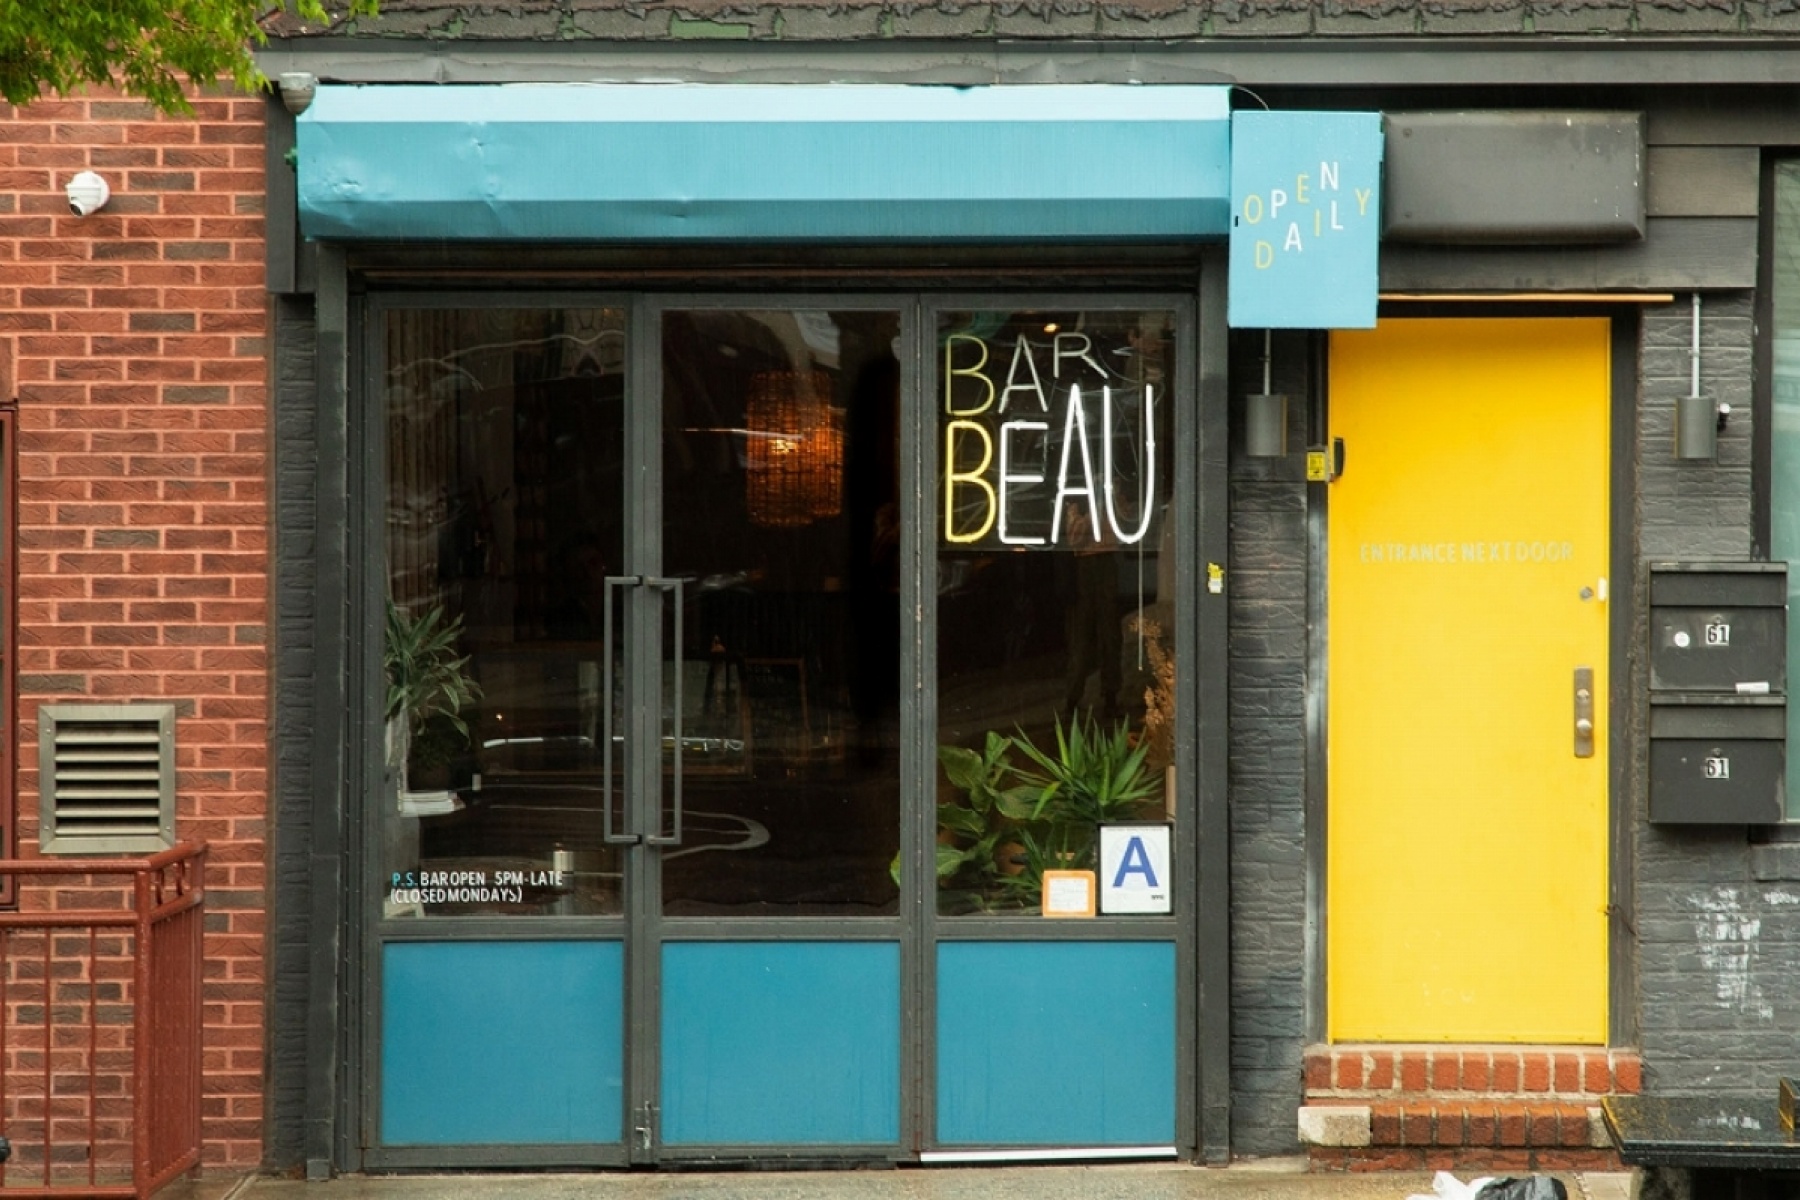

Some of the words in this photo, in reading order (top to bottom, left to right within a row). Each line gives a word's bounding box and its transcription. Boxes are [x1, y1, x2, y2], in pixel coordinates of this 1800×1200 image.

[1243, 161, 1340, 224] OPEN
[1255, 188, 1371, 269] DAILY
[945, 332, 1109, 415] BAR
[945, 382, 1155, 544] BEAU
[1360, 542, 1457, 563] ENTRANCE
[1460, 542, 1511, 562] NEXT
[1515, 541, 1573, 562] DOOR
[1707, 625, 1729, 644] 61
[1707, 759, 1729, 777] 61
[1112, 835, 1159, 888] A
